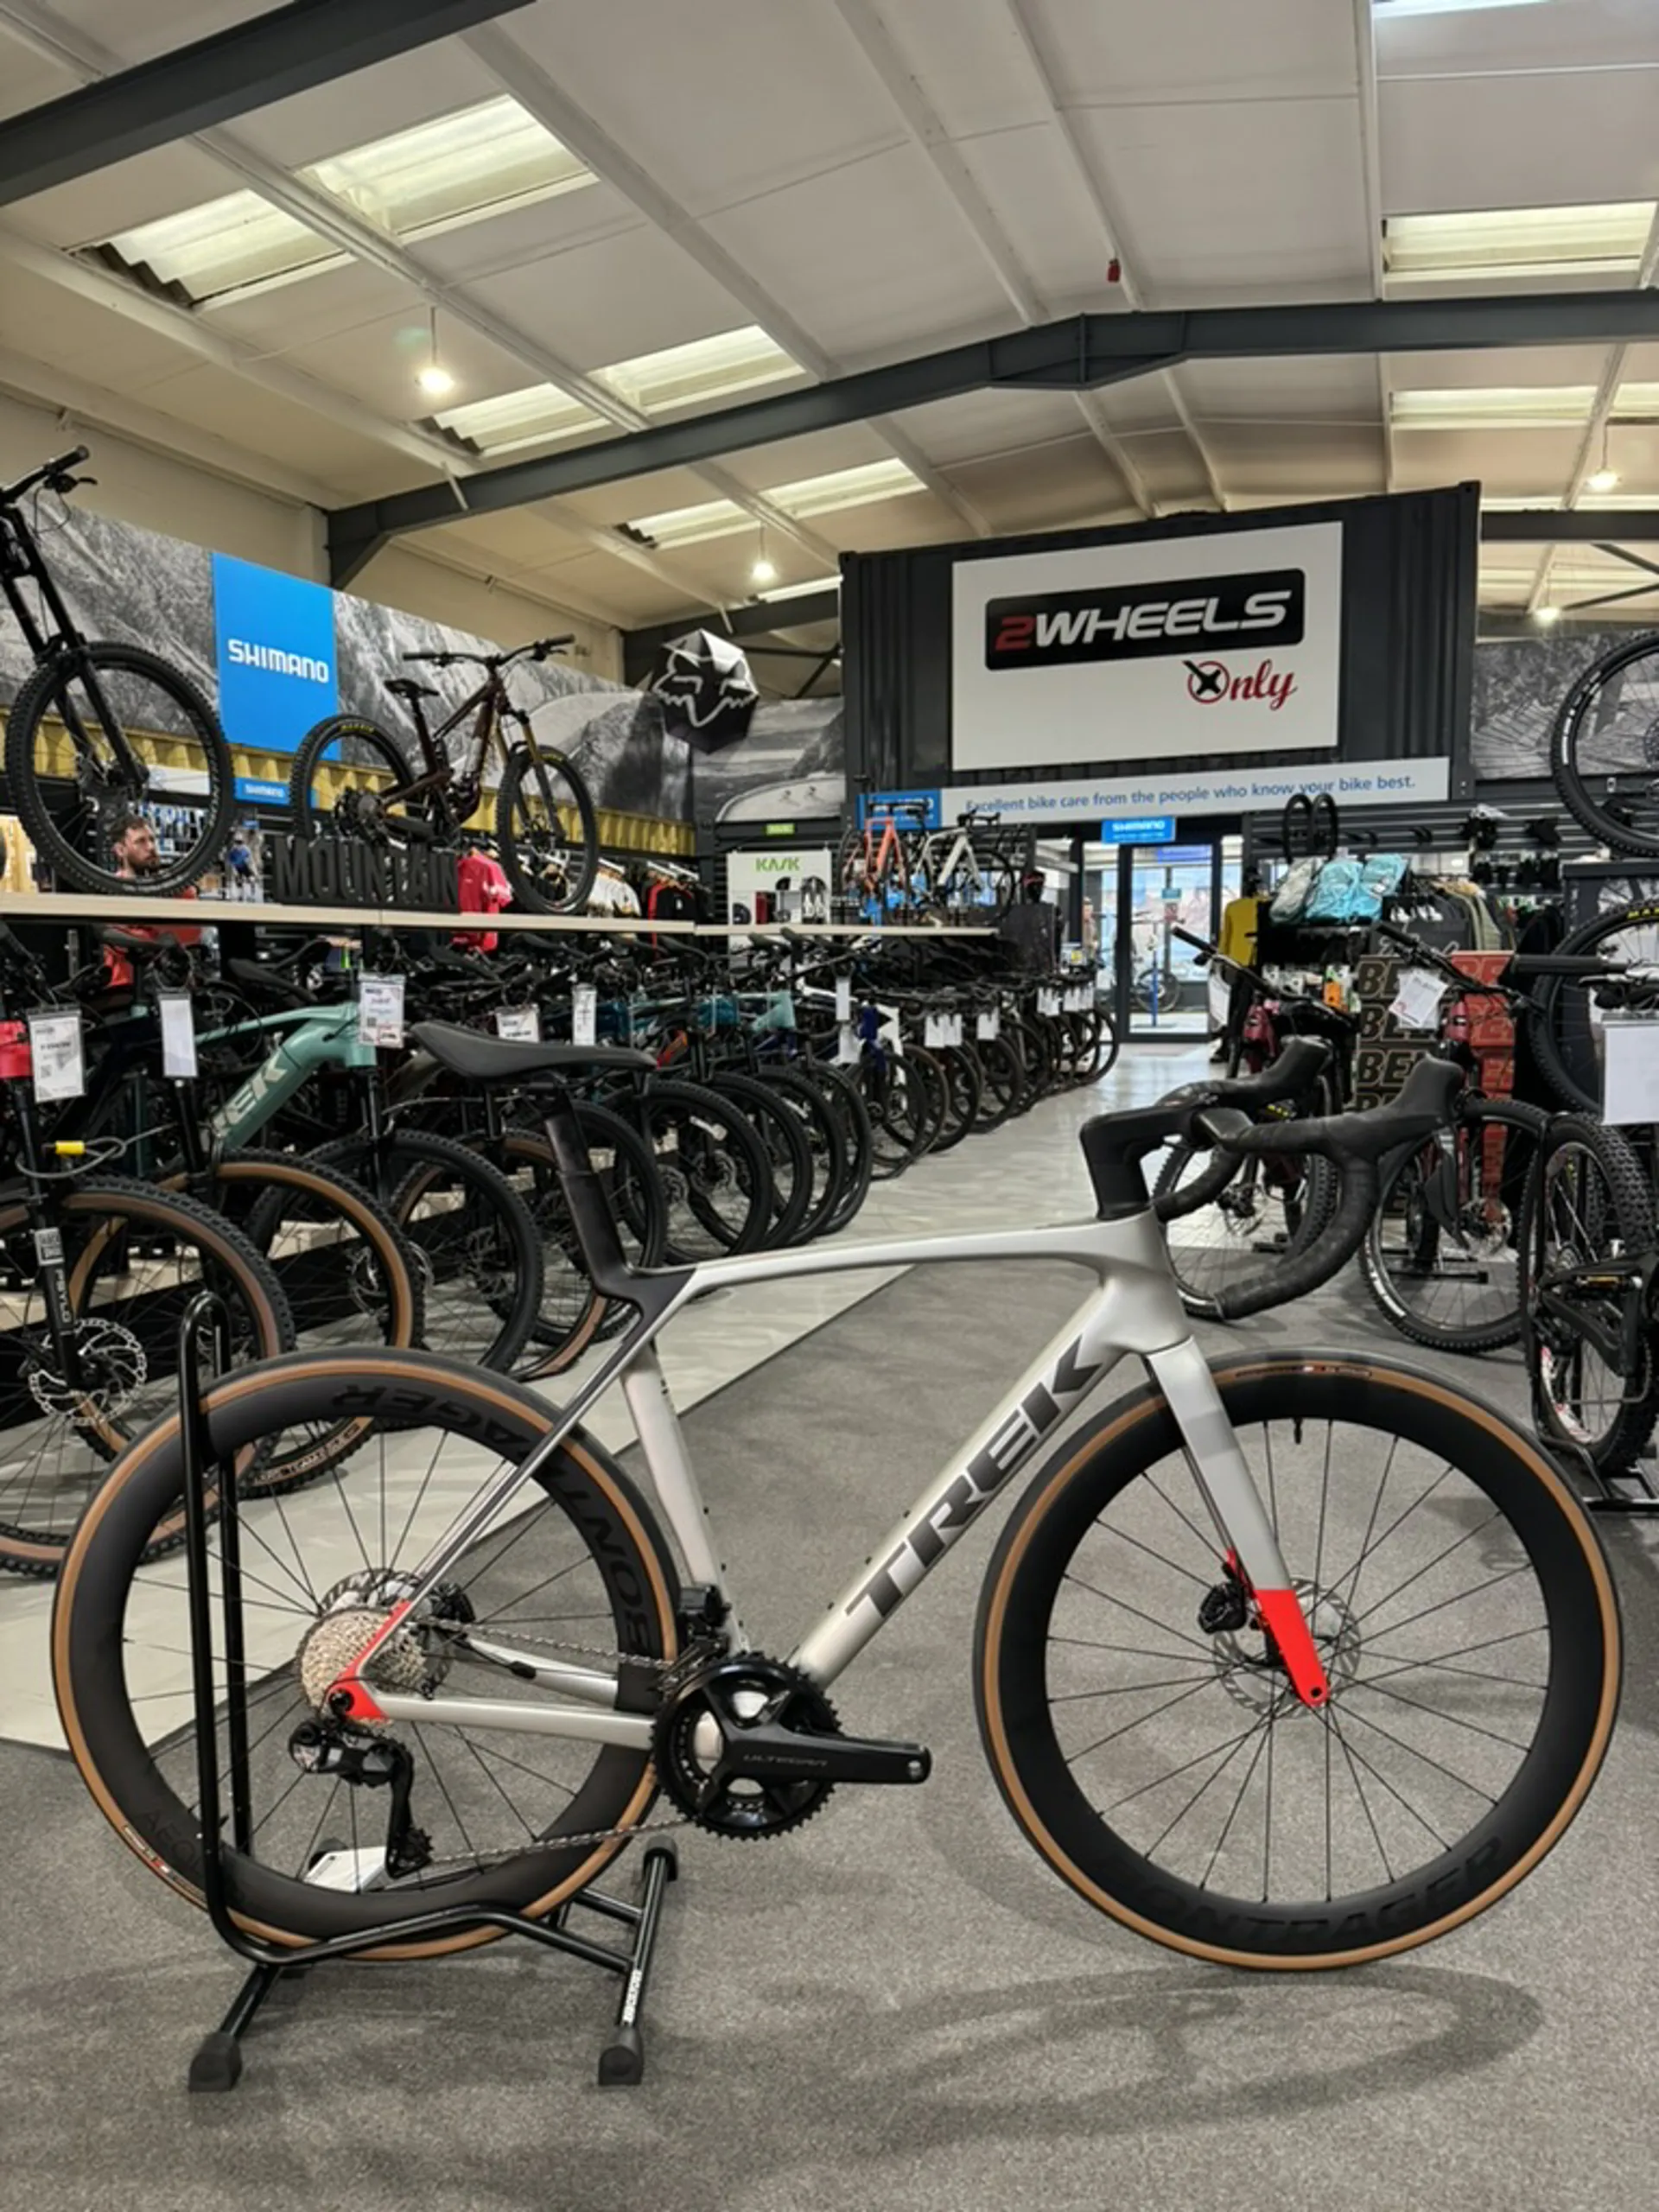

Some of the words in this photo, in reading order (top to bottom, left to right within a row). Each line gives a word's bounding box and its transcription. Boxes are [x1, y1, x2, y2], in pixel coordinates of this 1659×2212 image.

[995, 590, 1292, 650] 2WHEELS
[228, 639, 329, 683] SHIMANO
[1184, 659, 1298, 711] Only
[965, 798, 1025, 813] Excellent
[1028, 795, 1056, 810] bike
[1060, 795, 1089, 808] care
[1093, 792, 1128, 807] from
[1132, 791, 1155, 804] the
[1158, 786, 1210, 806] people
[1213, 785, 1248, 799] who
[1251, 783, 1296, 797] know
[1299, 780, 1336, 796] your
[1339, 777, 1373, 792] bike
[1377, 775, 1416, 791] best.
[275, 836, 461, 905] MOUNTAIN
[844, 1334, 1103, 1618] TREK
